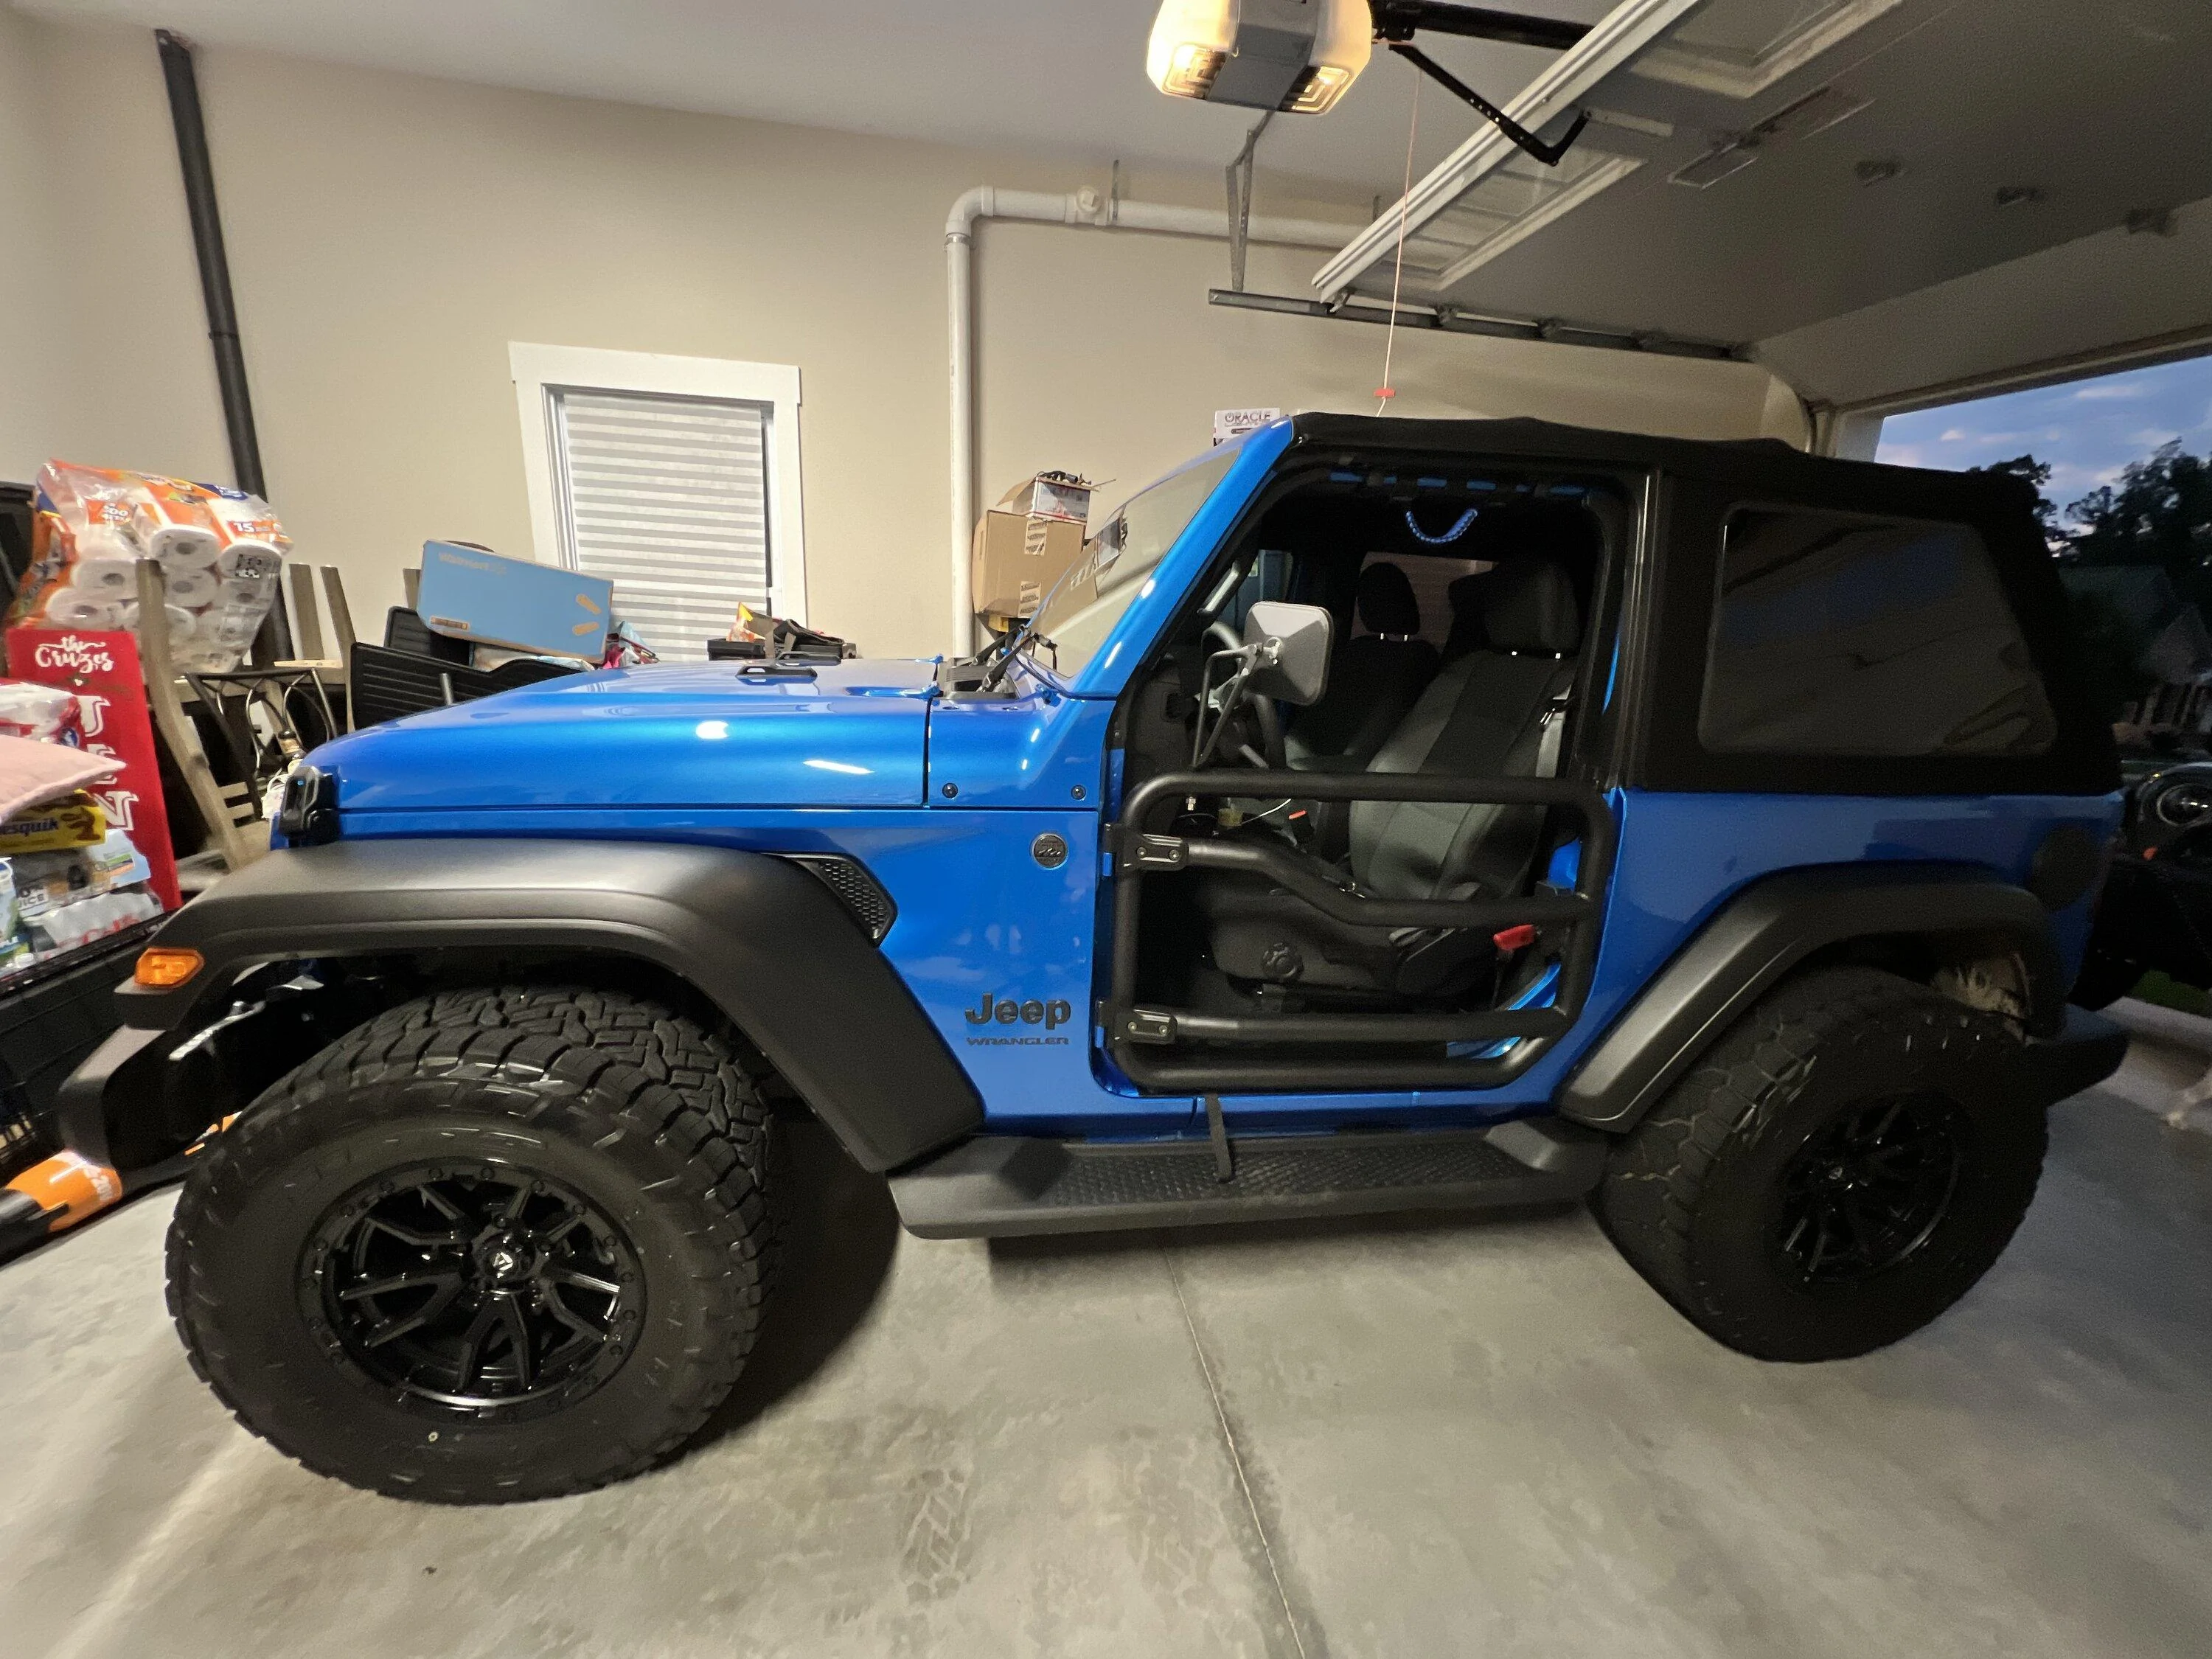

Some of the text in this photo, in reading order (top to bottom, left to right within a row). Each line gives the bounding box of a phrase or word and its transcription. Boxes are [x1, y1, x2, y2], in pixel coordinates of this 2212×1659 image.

[1225, 411, 1270, 423] ORACLE
[233, 522, 256, 533] 15
[35, 647, 114, 674] Cruzes
[964, 992, 1071, 1030] Jeep
[966, 1037, 1069, 1046] WRANGLER
